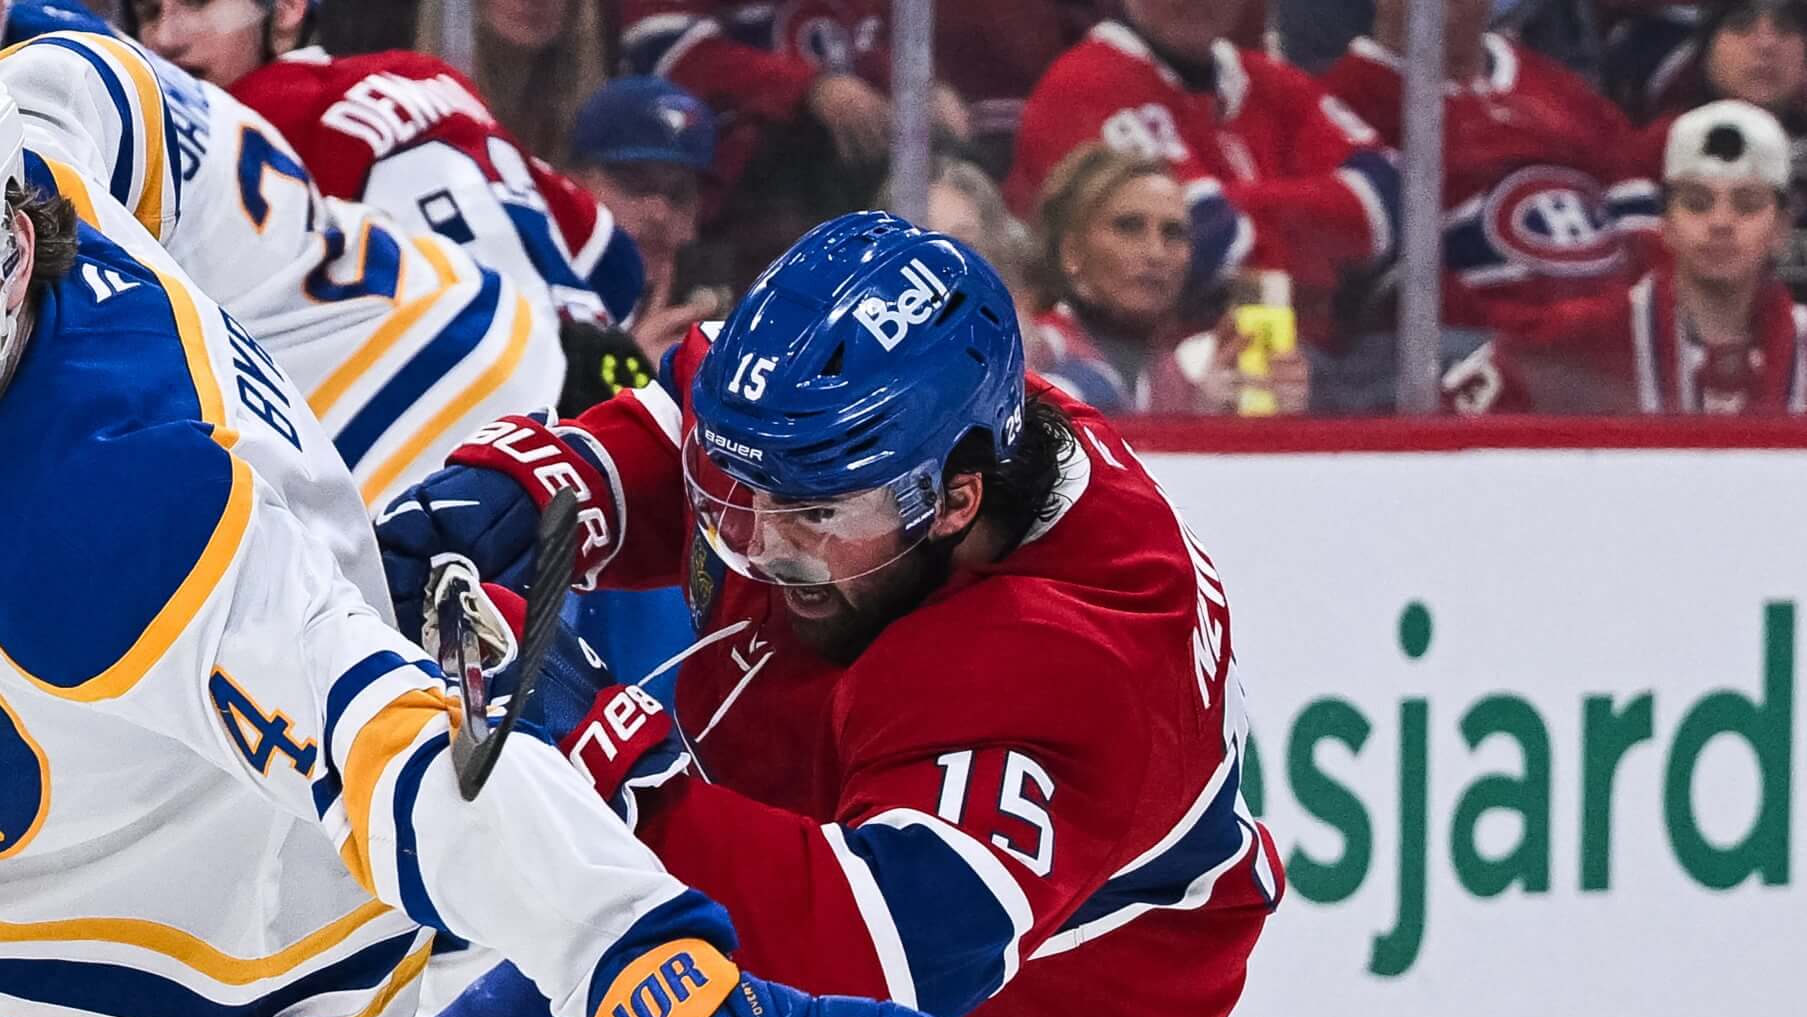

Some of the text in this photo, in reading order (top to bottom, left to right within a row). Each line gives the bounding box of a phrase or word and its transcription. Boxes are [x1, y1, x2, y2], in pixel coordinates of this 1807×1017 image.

[853, 258, 956, 352] Bell
[727, 353, 778, 401] 15
[460, 421, 609, 557] AUER
[704, 429, 763, 462] BAUER
[209, 664, 318, 780] 4
[936, 748, 1056, 878] 15
[1242, 600, 1795, 976] sjard
